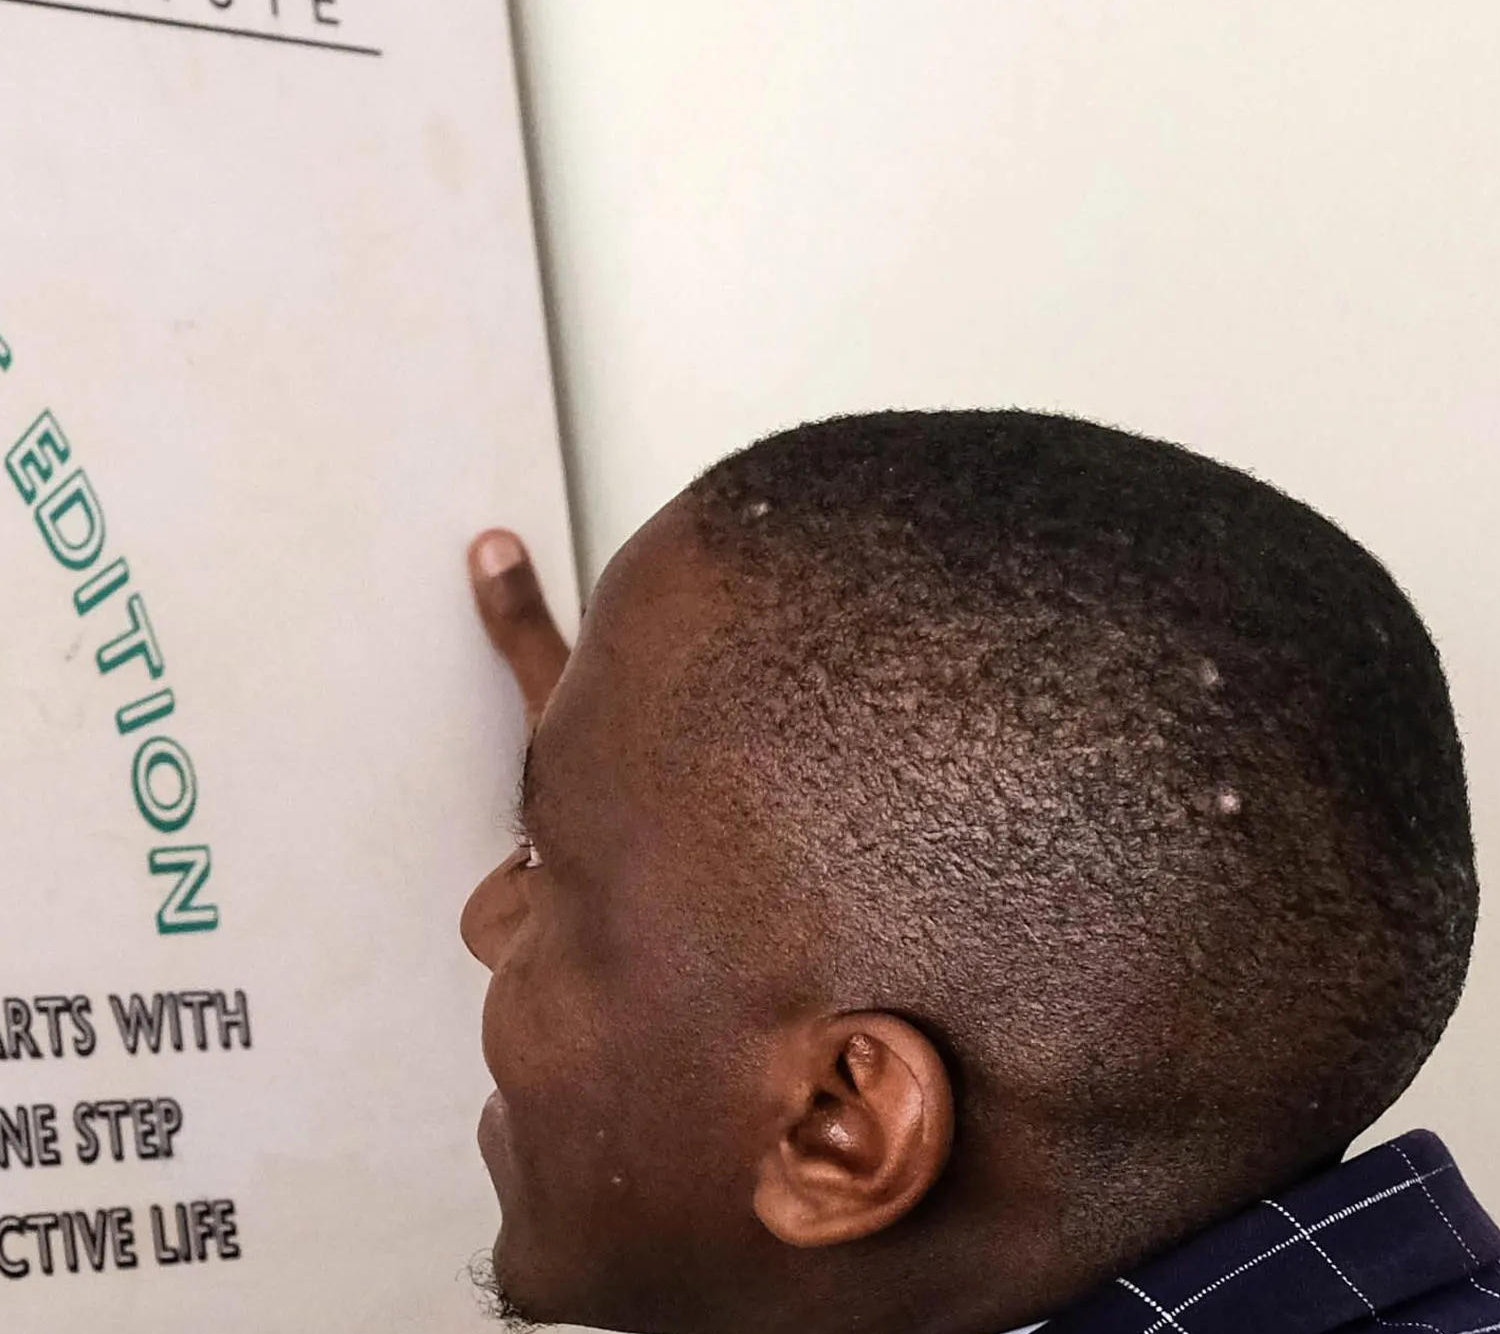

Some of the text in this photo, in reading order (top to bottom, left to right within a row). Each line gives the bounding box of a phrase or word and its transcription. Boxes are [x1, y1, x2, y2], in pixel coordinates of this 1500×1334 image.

[3, 407, 220, 935] EDITION
[109, 989, 252, 1053] WITH
[73, 1097, 183, 1164] STEP
[149, 1200, 241, 1267] LIFE
